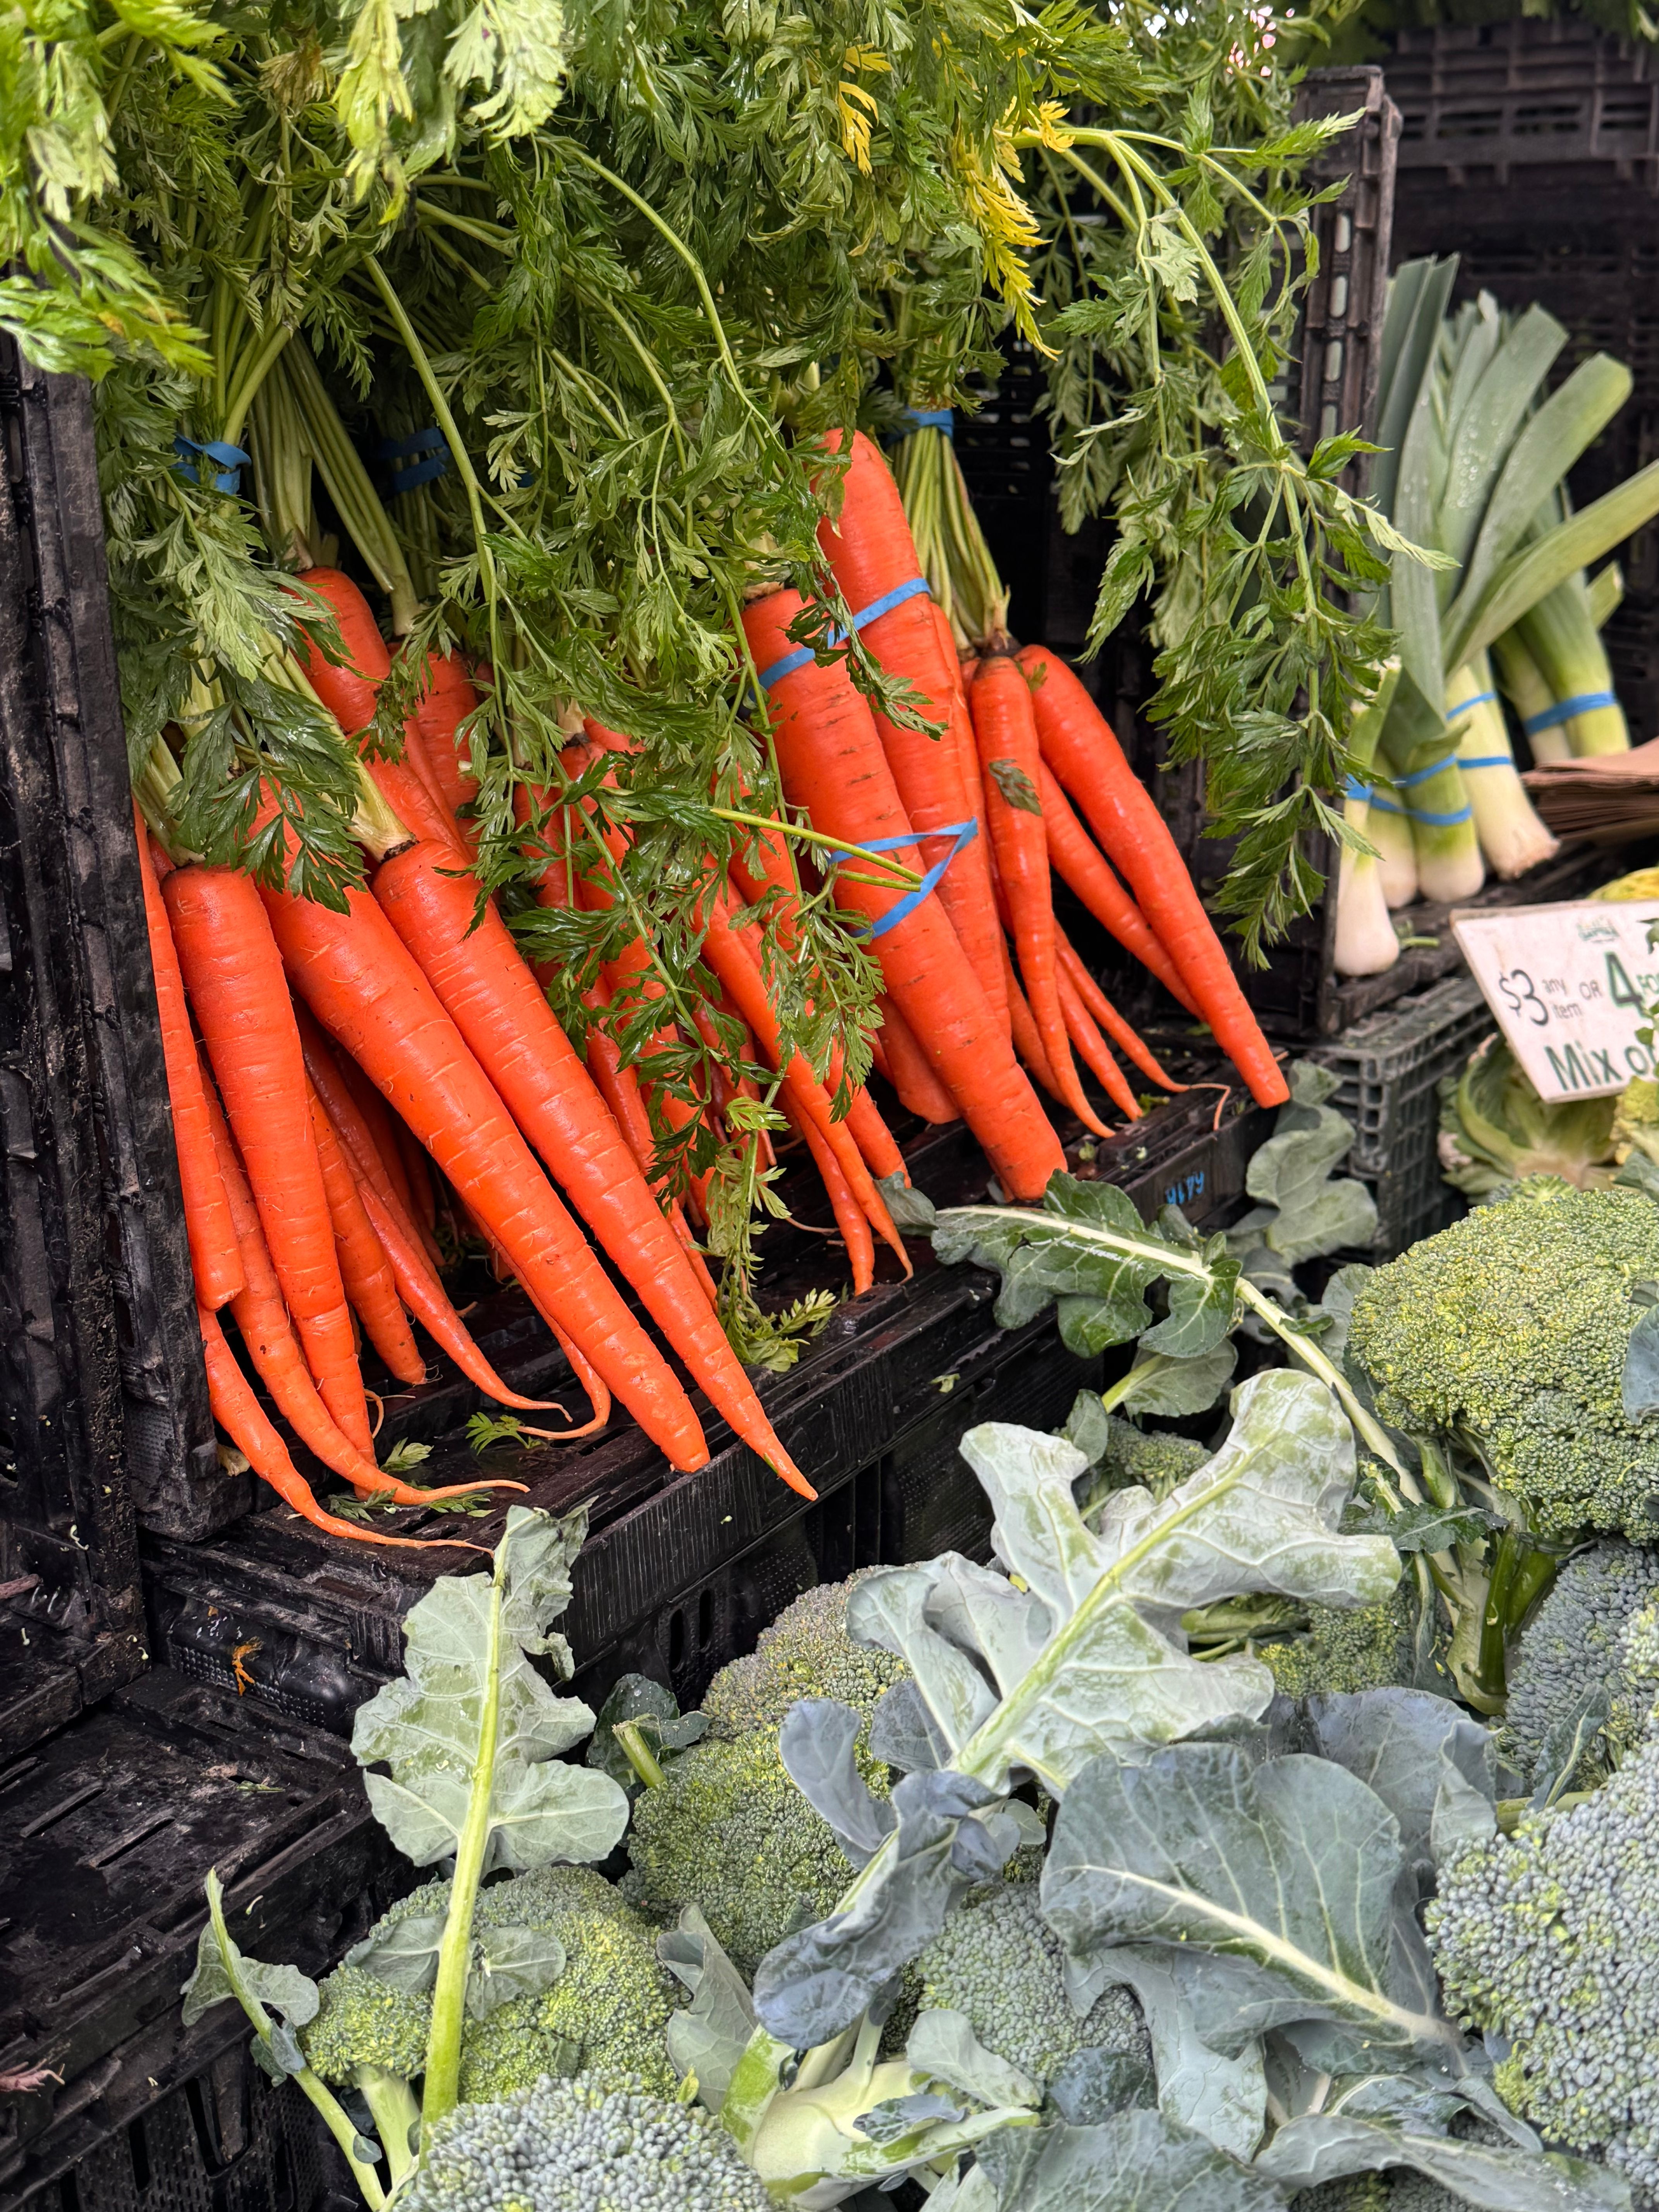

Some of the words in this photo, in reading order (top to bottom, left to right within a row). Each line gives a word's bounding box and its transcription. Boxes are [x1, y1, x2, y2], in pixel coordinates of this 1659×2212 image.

[1499, 969, 1549, 1026] $3
[1542, 978, 1567, 996] any
[1579, 979, 1602, 1000] OR
[1604, 951, 1647, 1018] 4
[1636, 973, 1659, 994] FO
[1550, 1002, 1583, 1019] item
[1544, 1040, 1622, 1091] Mix
